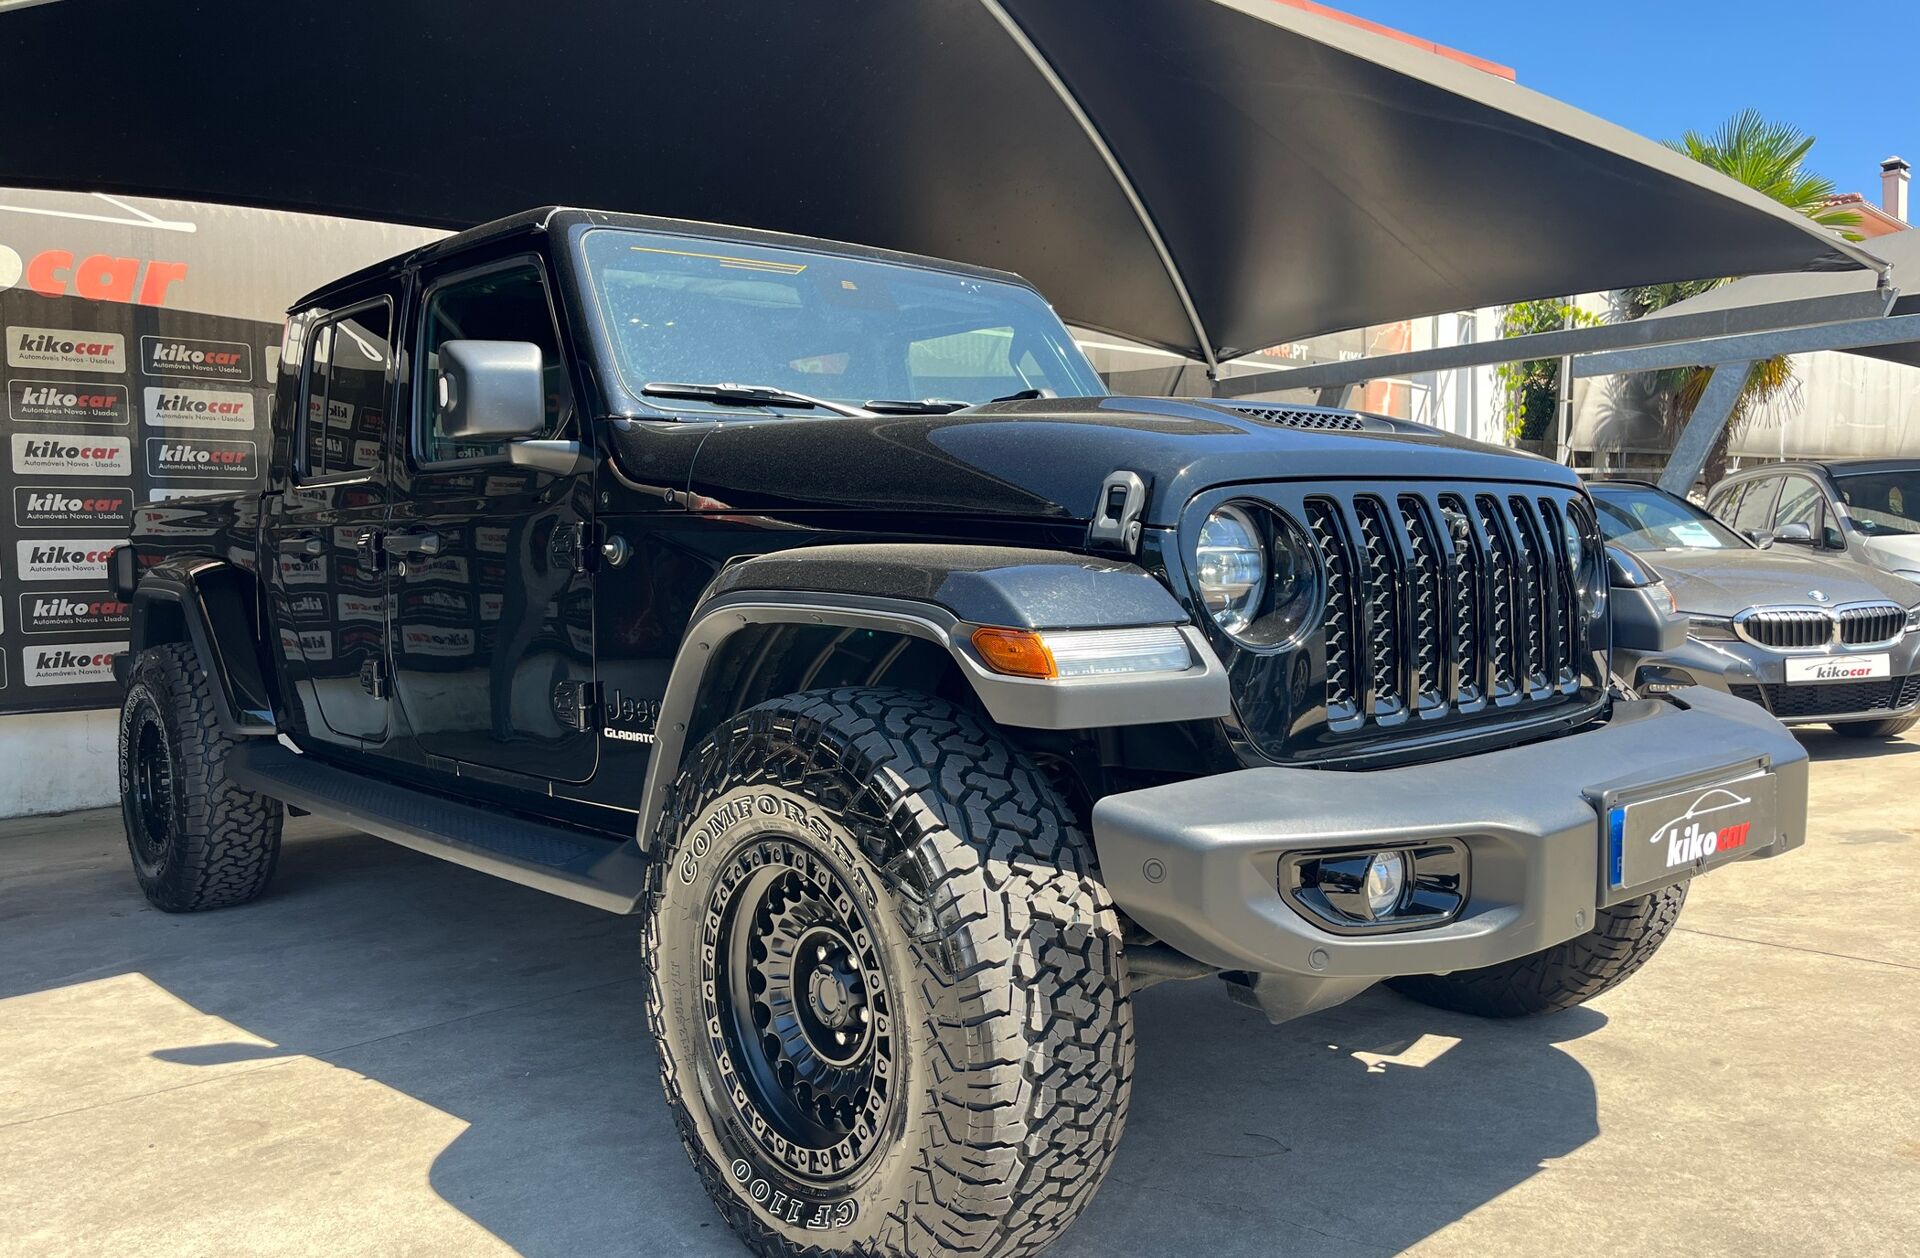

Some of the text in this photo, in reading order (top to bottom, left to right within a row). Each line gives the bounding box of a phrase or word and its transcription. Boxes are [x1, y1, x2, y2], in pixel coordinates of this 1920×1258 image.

[19, 334, 114, 356] kikocar
[153, 343, 240, 365] kikocar
[1256, 343, 1308, 360] CAR.PT
[19, 353, 59, 361] Automóveis
[153, 361, 191, 370] Automóveis
[218, 366, 242, 374] Usados
[22, 387, 117, 408] kikocar
[156, 394, 244, 414] kikocar
[21, 406, 62, 414] Automóveis
[92, 409, 118, 417] Usados
[24, 440, 120, 460] kikocar
[158, 444, 247, 464] kikocar
[223, 464, 248, 472] Usados
[26, 493, 124, 512] kikocar
[26, 512, 68, 520] Automóveis
[30, 546, 108, 564] kikoca
[33, 599, 128, 617] kikocar
[33, 618, 74, 626] Automóveis
[36, 651, 113, 669] kikoca
[36, 670, 77, 678] Automóveis
[1816, 666, 1872, 678] kikocar
[604, 727, 655, 744] GLADIATO
[1666, 821, 1751, 868] kikocar
